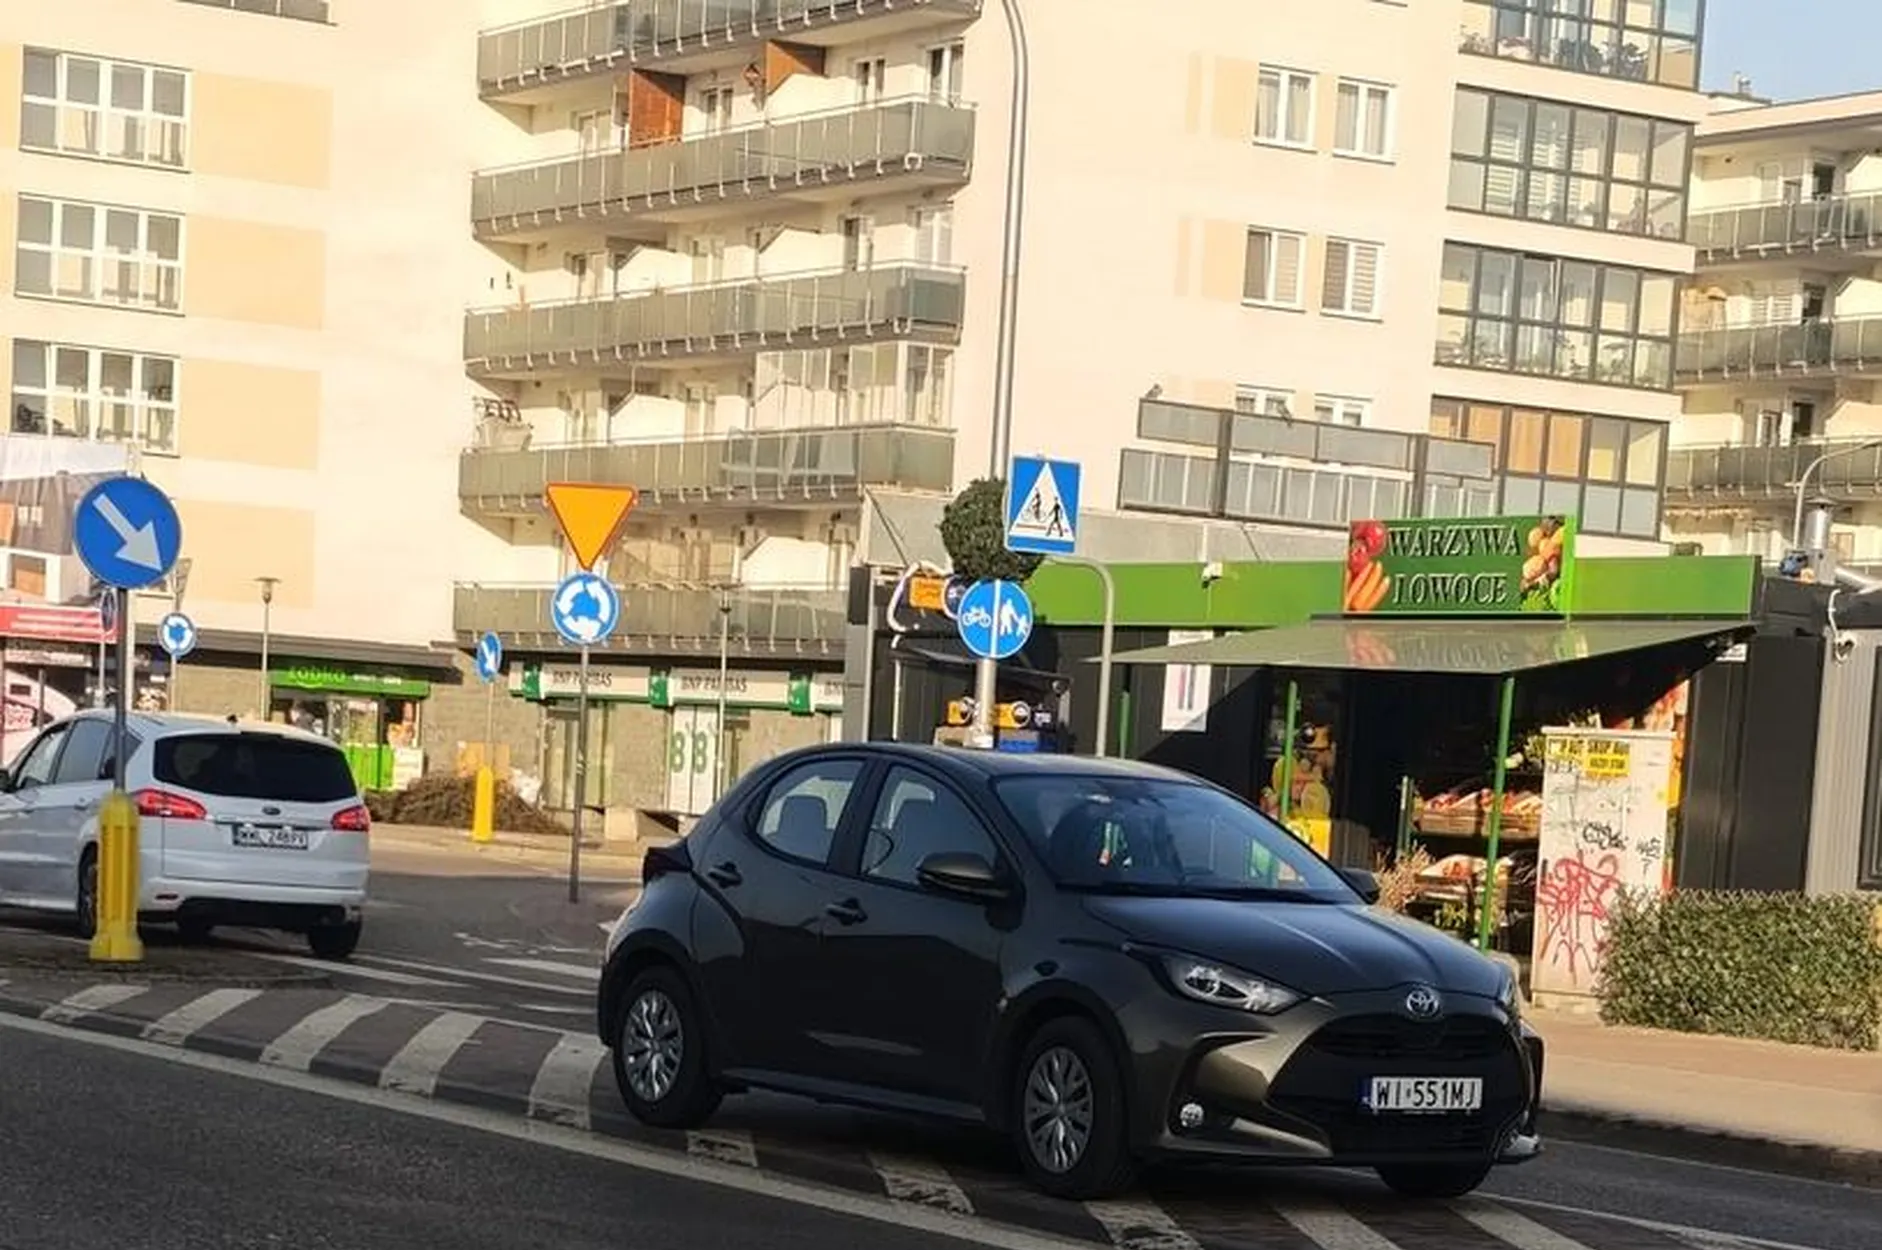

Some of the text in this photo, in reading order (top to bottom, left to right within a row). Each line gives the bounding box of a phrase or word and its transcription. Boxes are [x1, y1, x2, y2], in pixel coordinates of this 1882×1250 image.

[1388, 524, 1521, 556] WARZYWA
[1392, 572, 1508, 604] I OWOCE
[1377, 1080, 1476, 1107] WI 551MJ
